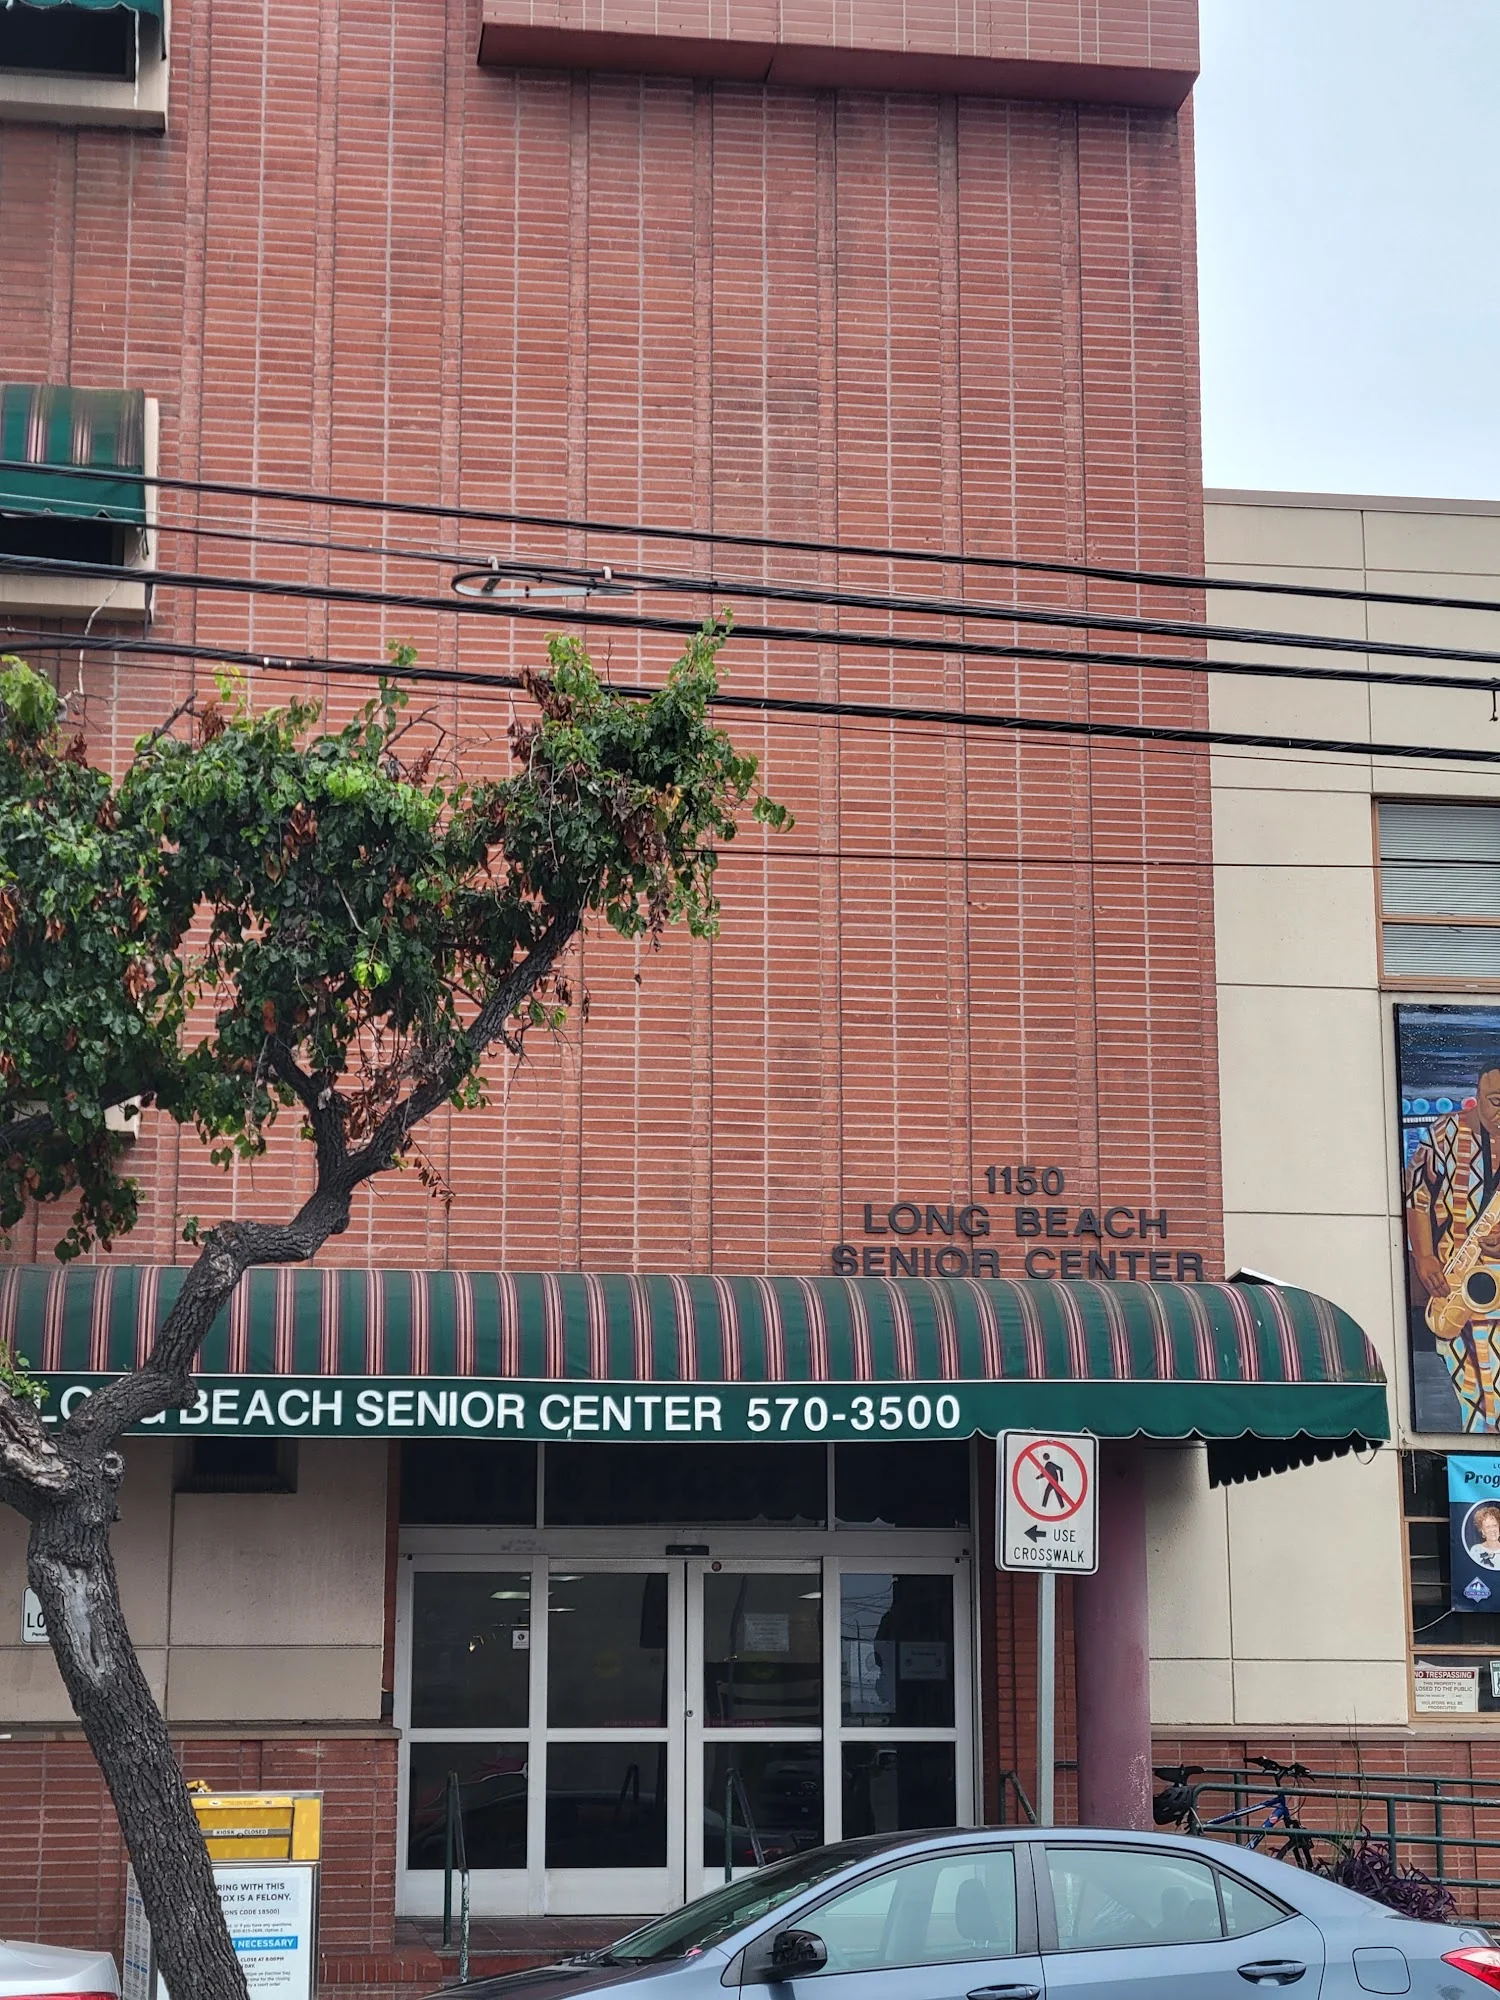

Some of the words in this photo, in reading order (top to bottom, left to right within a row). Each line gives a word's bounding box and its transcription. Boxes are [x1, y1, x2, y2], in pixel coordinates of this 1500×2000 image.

[984, 1165, 1065, 1196] 1150
[864, 1203, 991, 1236] LONG
[1015, 1206, 1168, 1238] BEACH
[831, 1244, 1001, 1278] SENIOR
[1024, 1249, 1204, 1282] CENTER
[179, 1388, 342, 1427] BEACH
[355, 1390, 525, 1429] SENIOR
[539, 1395, 723, 1432] CENTER
[746, 1394, 961, 1431] 570-3500
[1053, 1529, 1076, 1542] USE
[1013, 1547, 1085, 1563] CROSSWALK
[27, 1612, 46, 1628] LO
[217, 1884, 238, 1892] RING
[240, 1883, 264, 1891] WITH
[265, 1882, 285, 1890] THIS
[219, 1894, 235, 1902] OX
[237, 1894, 245, 1902] IS
[247, 1894, 254, 1902] A
[256, 1893, 292, 1902] FELONY.
[237, 1939, 294, 1948] NECESSARY
